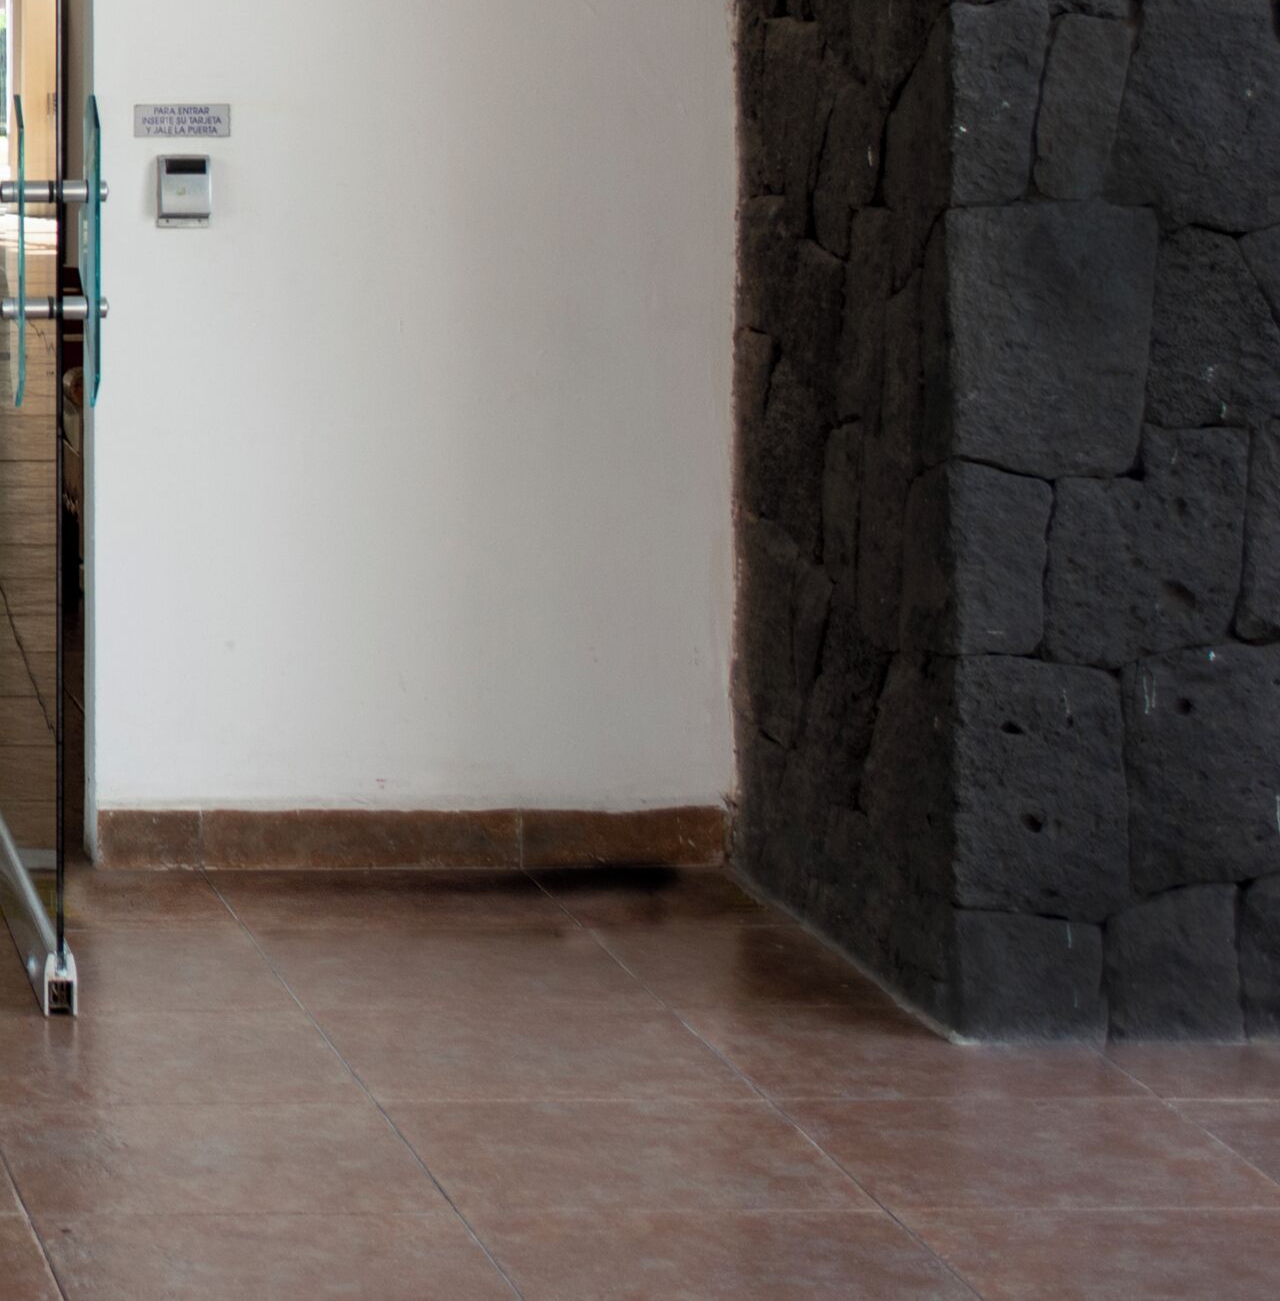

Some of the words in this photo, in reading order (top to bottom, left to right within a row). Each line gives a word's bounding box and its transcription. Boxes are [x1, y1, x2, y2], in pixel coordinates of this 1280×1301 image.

[154, 107, 175, 115] PARA
[178, 107, 210, 115] ENTRAR
[142, 116, 174, 125] INSERTE
[176, 116, 186, 124] SU
[189, 116, 222, 124] TARJETA
[146, 126, 151, 134] Y
[153, 126, 173, 134] JALE
[174, 126, 186, 134] LA
[188, 126, 217, 134] PUERTA
